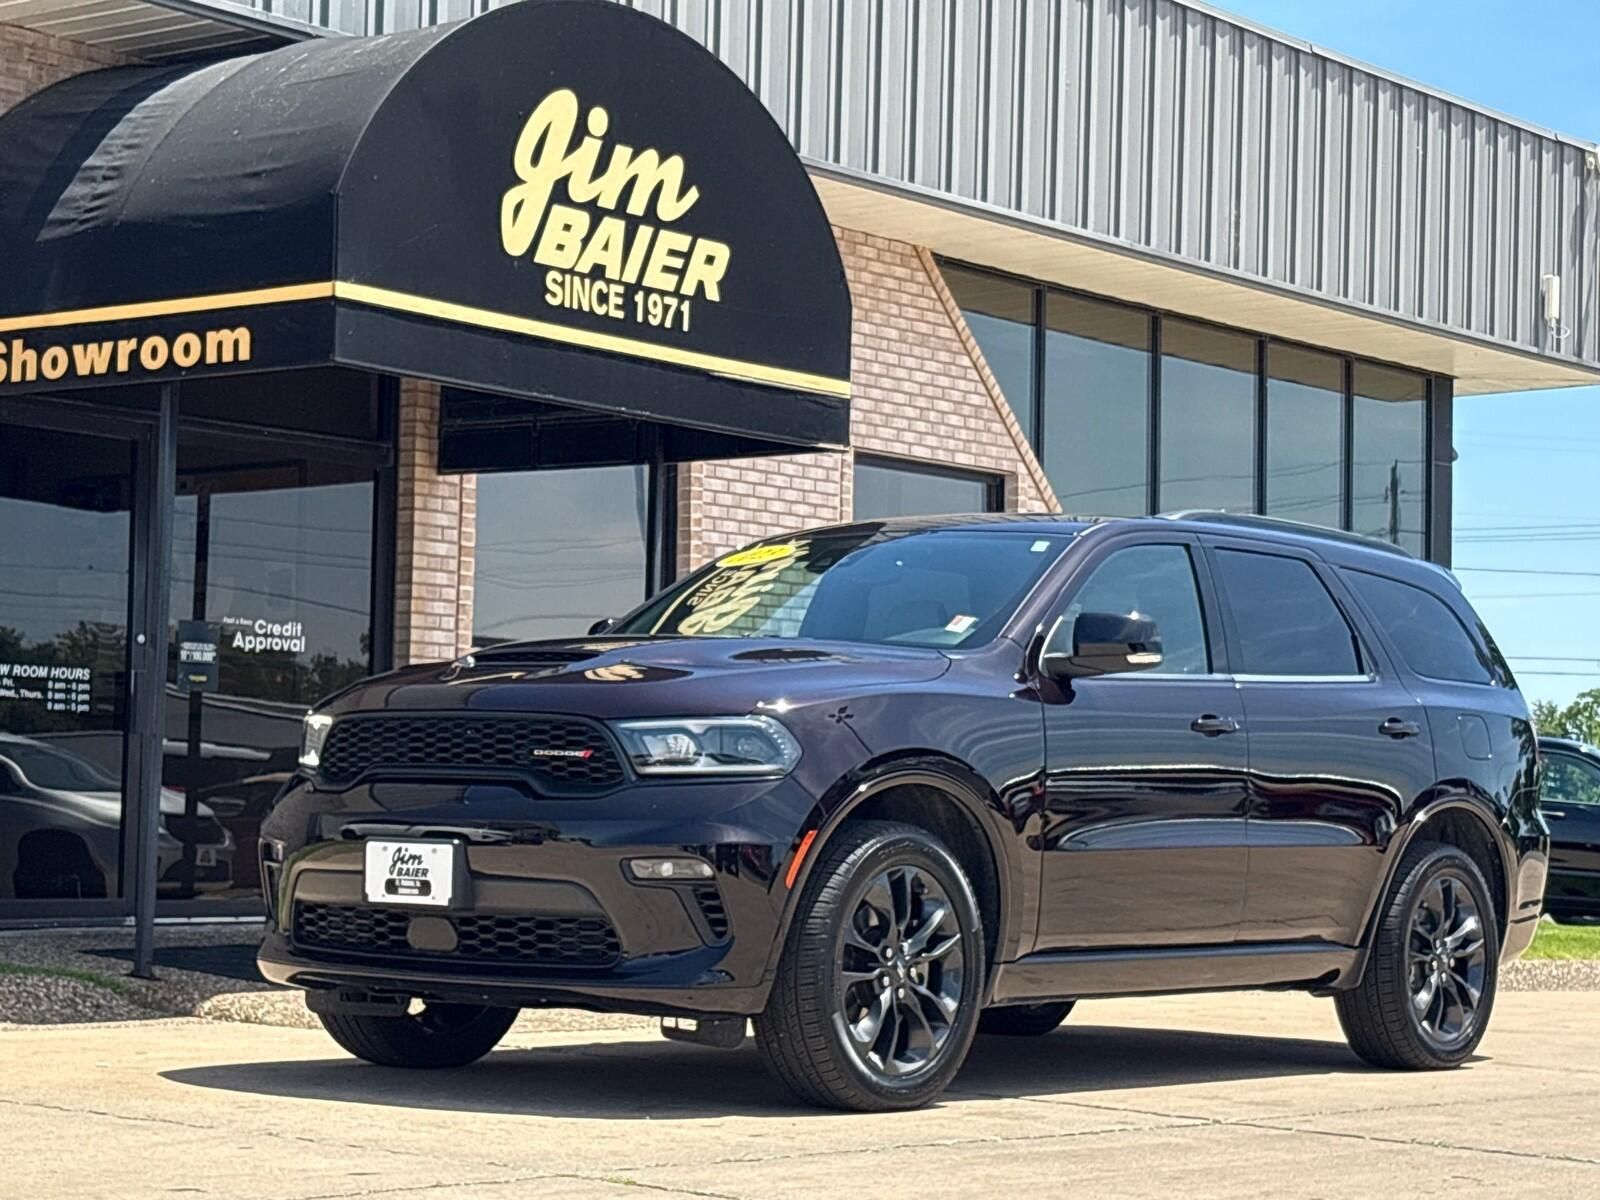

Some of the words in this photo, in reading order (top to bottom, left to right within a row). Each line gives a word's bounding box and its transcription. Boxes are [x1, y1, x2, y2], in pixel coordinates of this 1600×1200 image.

[501, 89, 699, 257] Jim
[533, 204, 730, 302] BAIER
[545, 270, 625, 320] SINCE
[634, 290, 690, 332] 1971
[254, 619, 302, 637] Credit
[232, 631, 305, 653] Approval
[12, 664, 48, 678] ROOM
[50, 666, 91, 680] HOURS
[389, 846, 424, 876] Jim
[396, 867, 429, 878] BAIER
